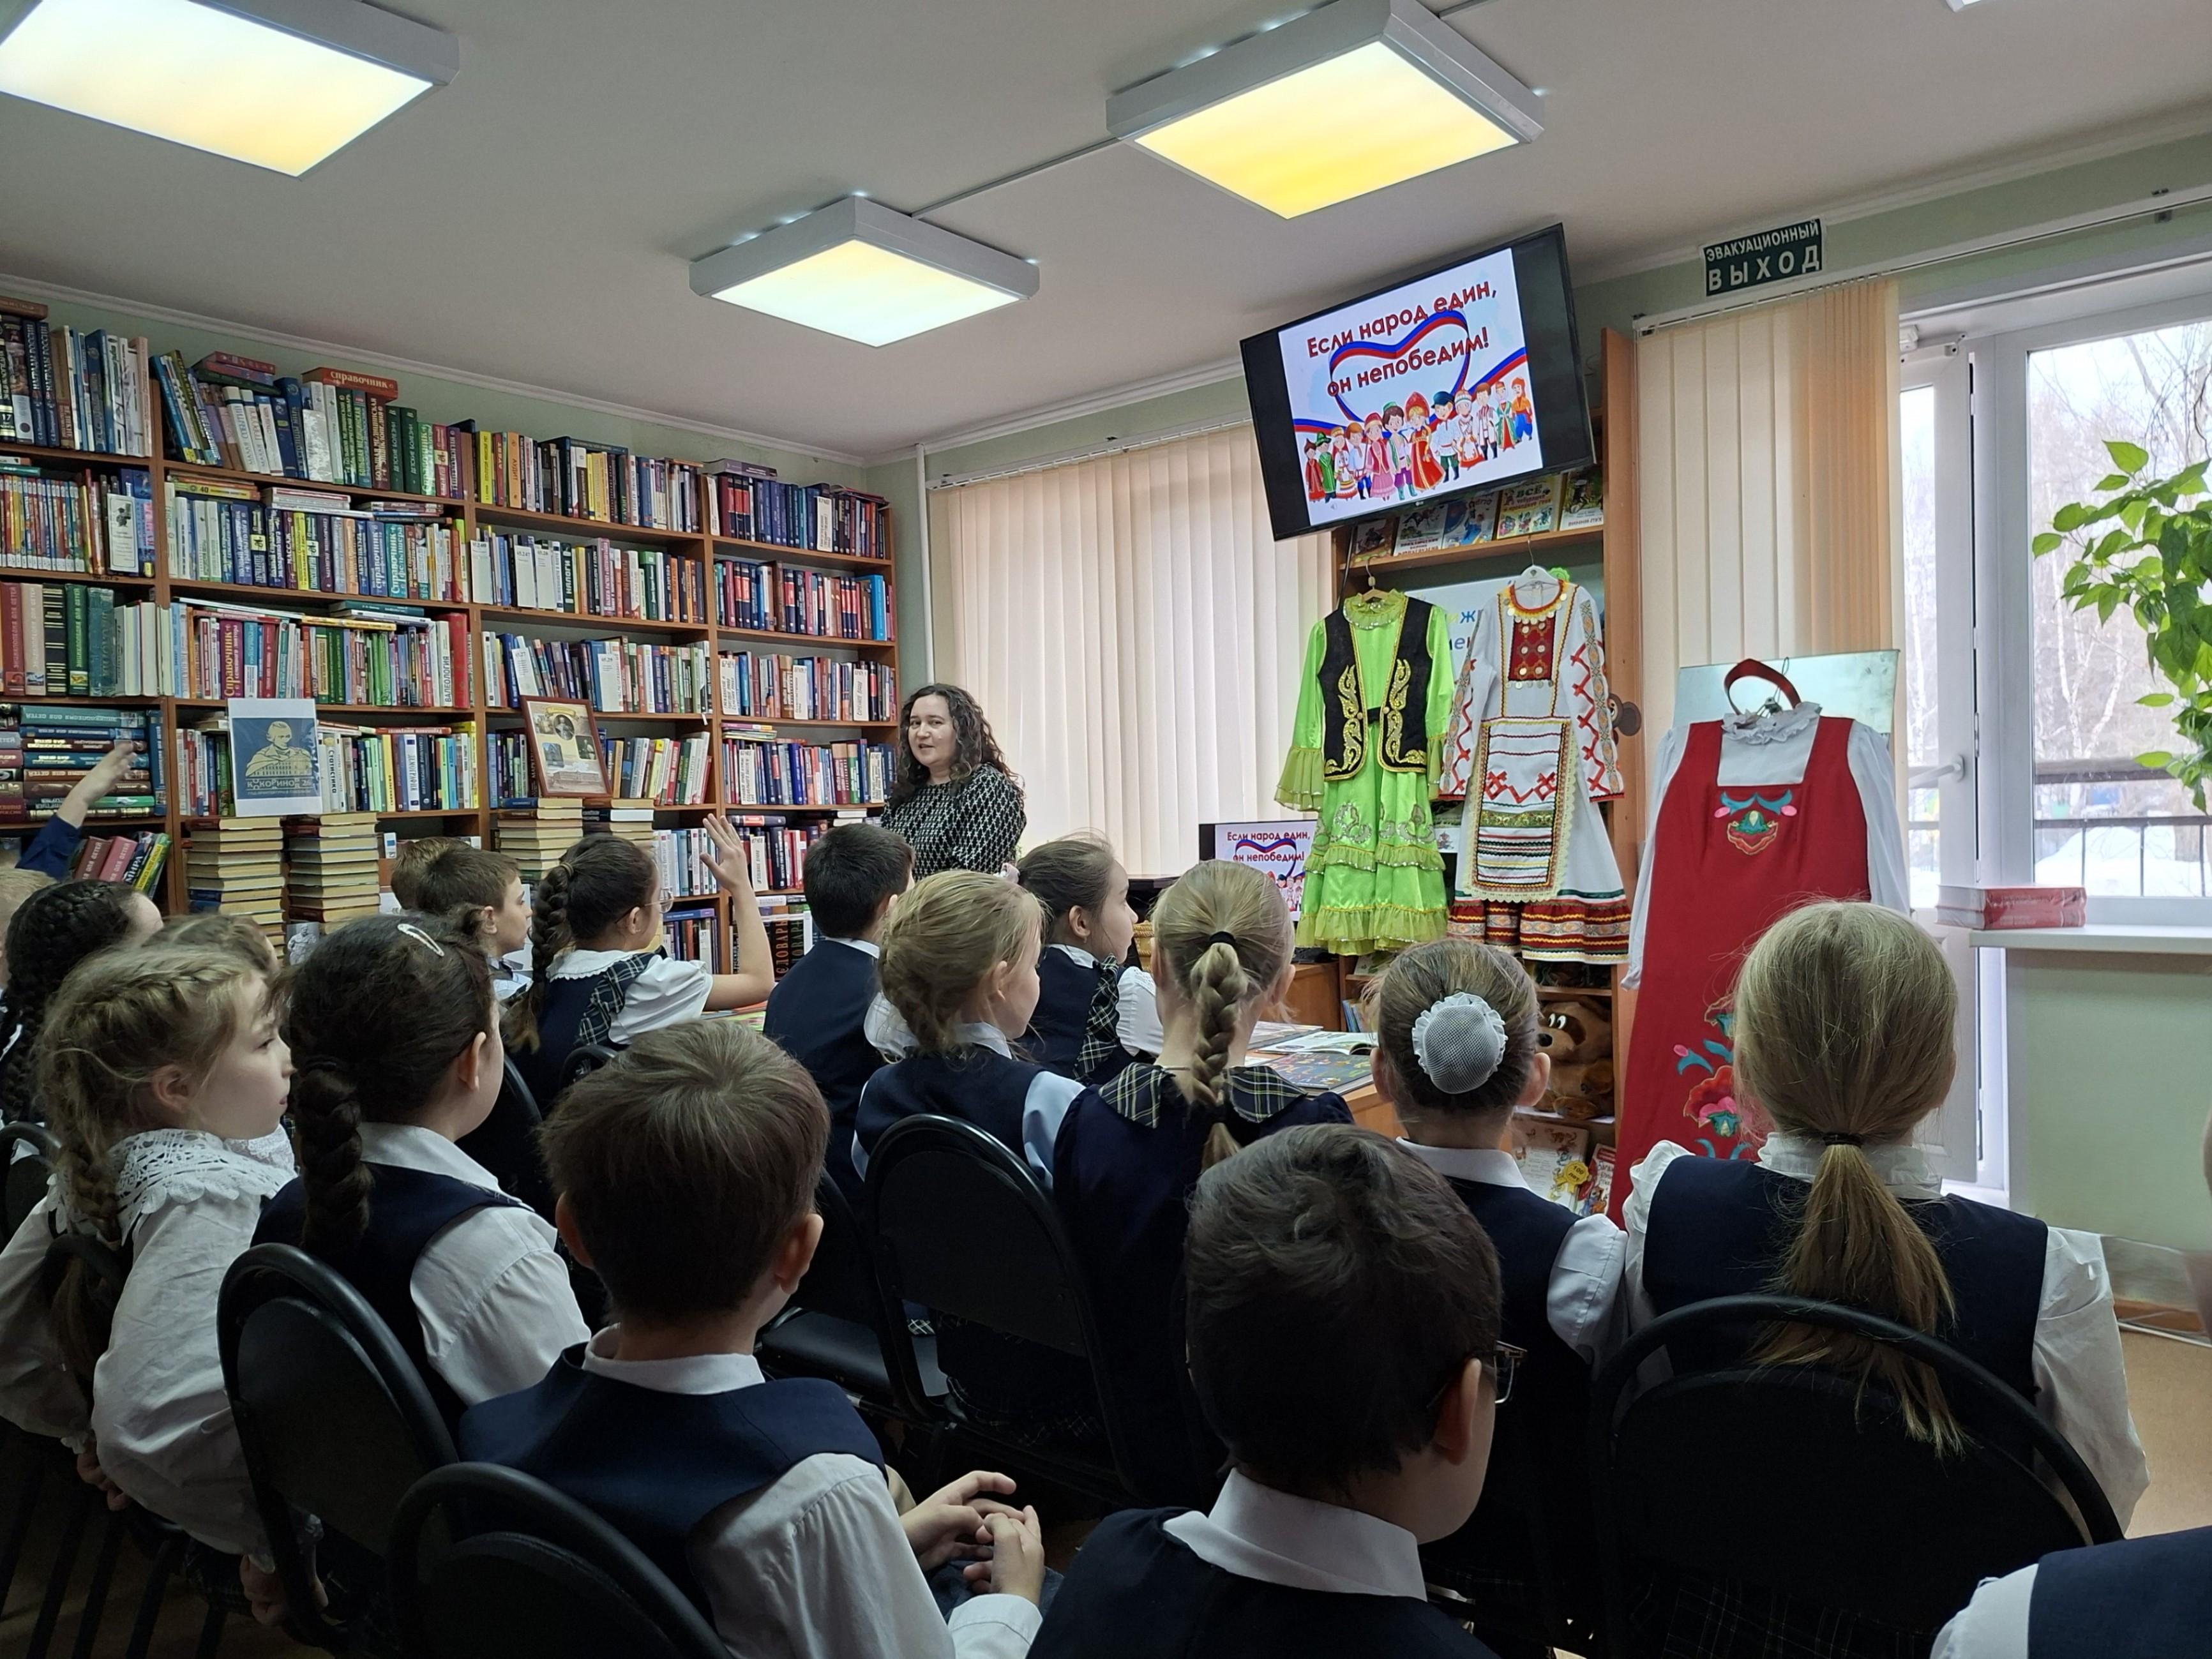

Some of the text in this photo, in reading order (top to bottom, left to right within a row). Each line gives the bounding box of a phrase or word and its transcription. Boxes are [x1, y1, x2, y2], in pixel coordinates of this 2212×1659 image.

[1706, 220, 1819, 262] ЭВАКУАЦИОННЫЙ
[1708, 245, 1819, 291] ВЫХОД
[1307, 282, 1496, 357] Если народ един,
[330, 371, 388, 388] справочник
[1327, 326, 1489, 396] он непобедим!
[372, 531, 384, 589] справочник
[389, 533, 406, 594] Справочник
[396, 527, 405, 578] фельдшера
[224, 631, 241, 696] Справочник
[442, 656, 451, 702] ВАЛЕОЛОГИЯ
[1227, 831, 1310, 842] Если народ един,
[1247, 852, 1304, 862] непобедим!
[124, 855, 143, 883] МИРА
[776, 920, 789, 973] СЛОВАРЬ
[1574, 1166, 1584, 1175] 100
